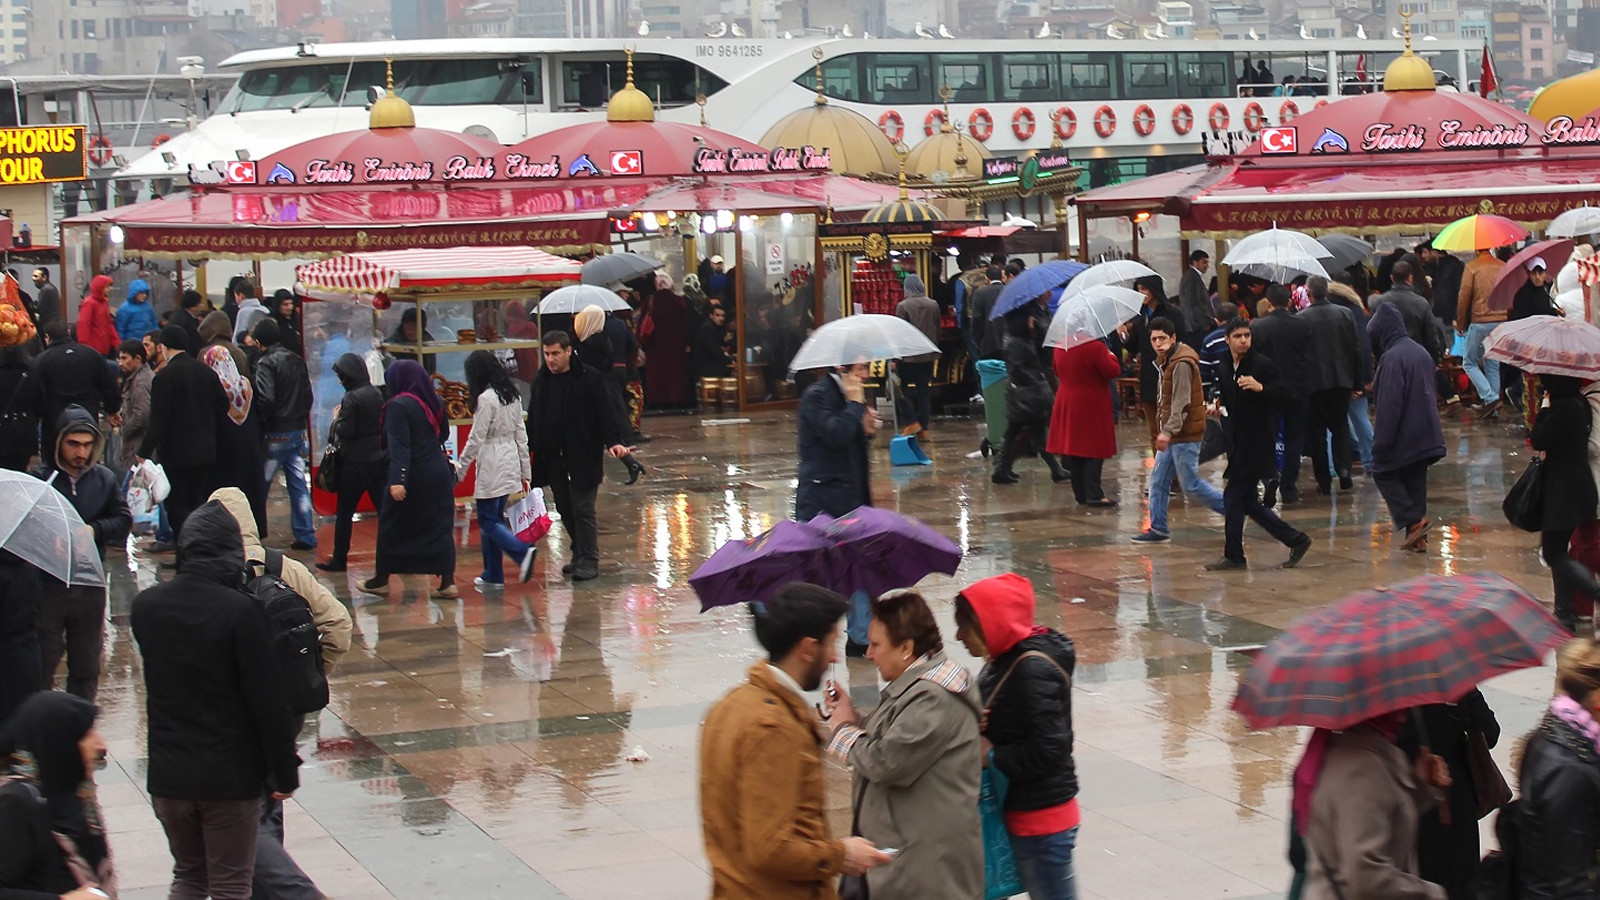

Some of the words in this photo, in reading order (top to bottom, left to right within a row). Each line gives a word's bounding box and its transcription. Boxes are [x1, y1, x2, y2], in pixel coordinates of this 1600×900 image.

[696, 45, 714, 57] IMO
[718, 45, 763, 57] 9641285
[0, 127, 76, 154] PHORUS
[1361, 123, 1426, 151] Tarihi
[1437, 119, 1530, 149] Eminönü
[0, 157, 44, 182] OUR
[304, 159, 354, 184] Tarihi
[363, 157, 434, 182] Eminönü
[441, 155, 495, 180] Balık
[505, 153, 561, 179] Ekmek
